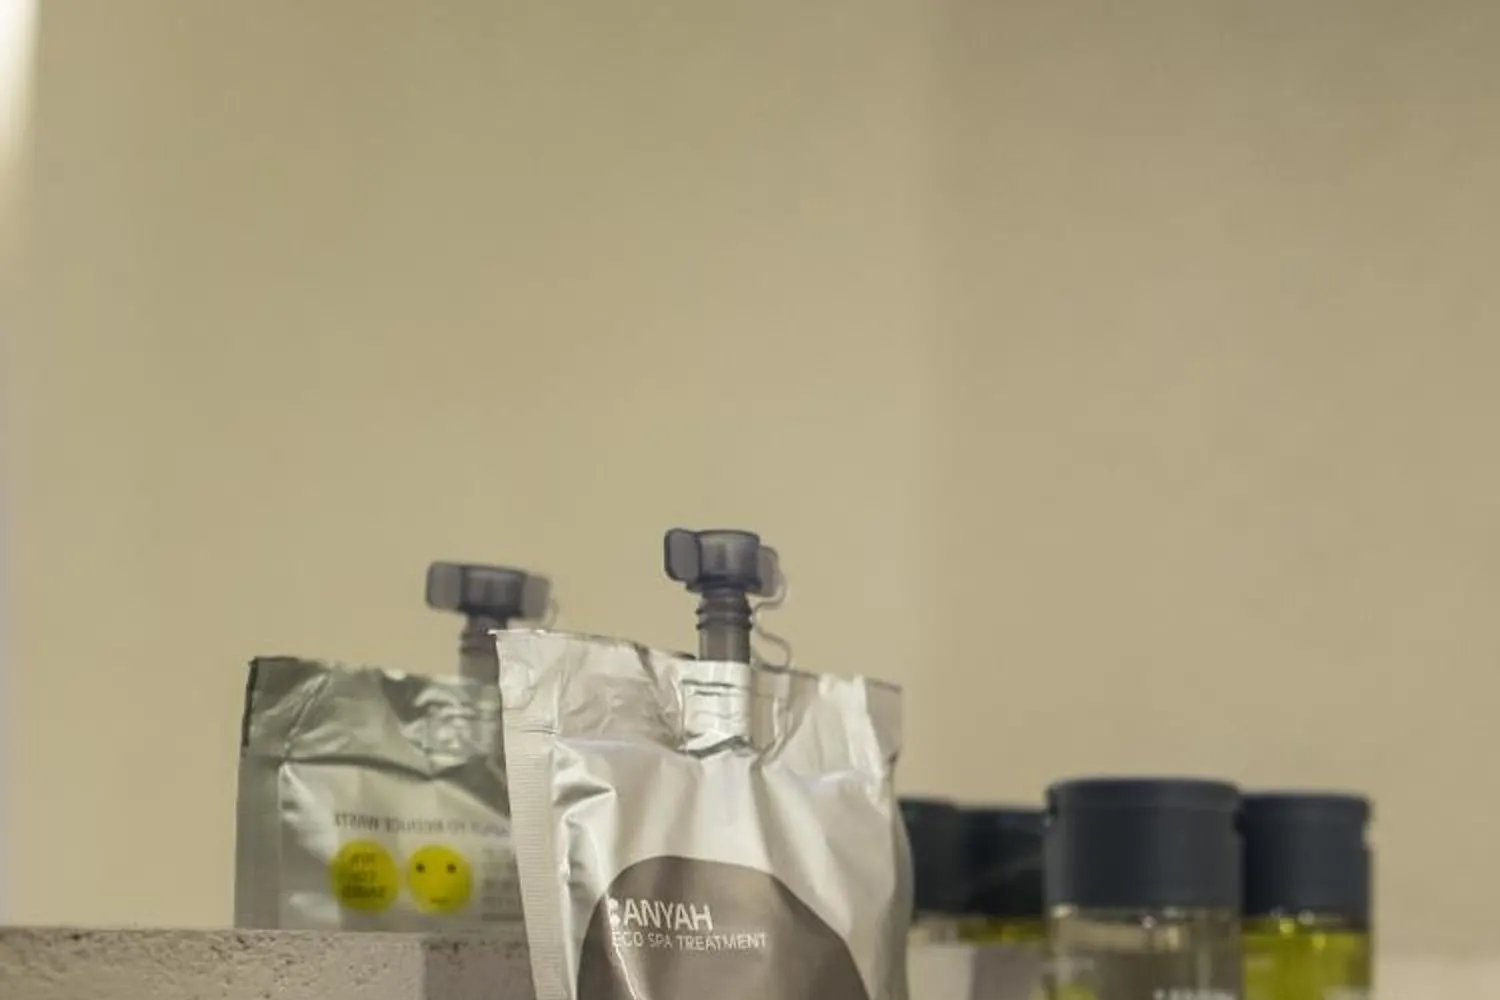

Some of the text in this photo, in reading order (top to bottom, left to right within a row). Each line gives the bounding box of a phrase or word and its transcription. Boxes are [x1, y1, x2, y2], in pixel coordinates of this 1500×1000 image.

[611, 931, 766, 951] ECO SPA TREATMENT
